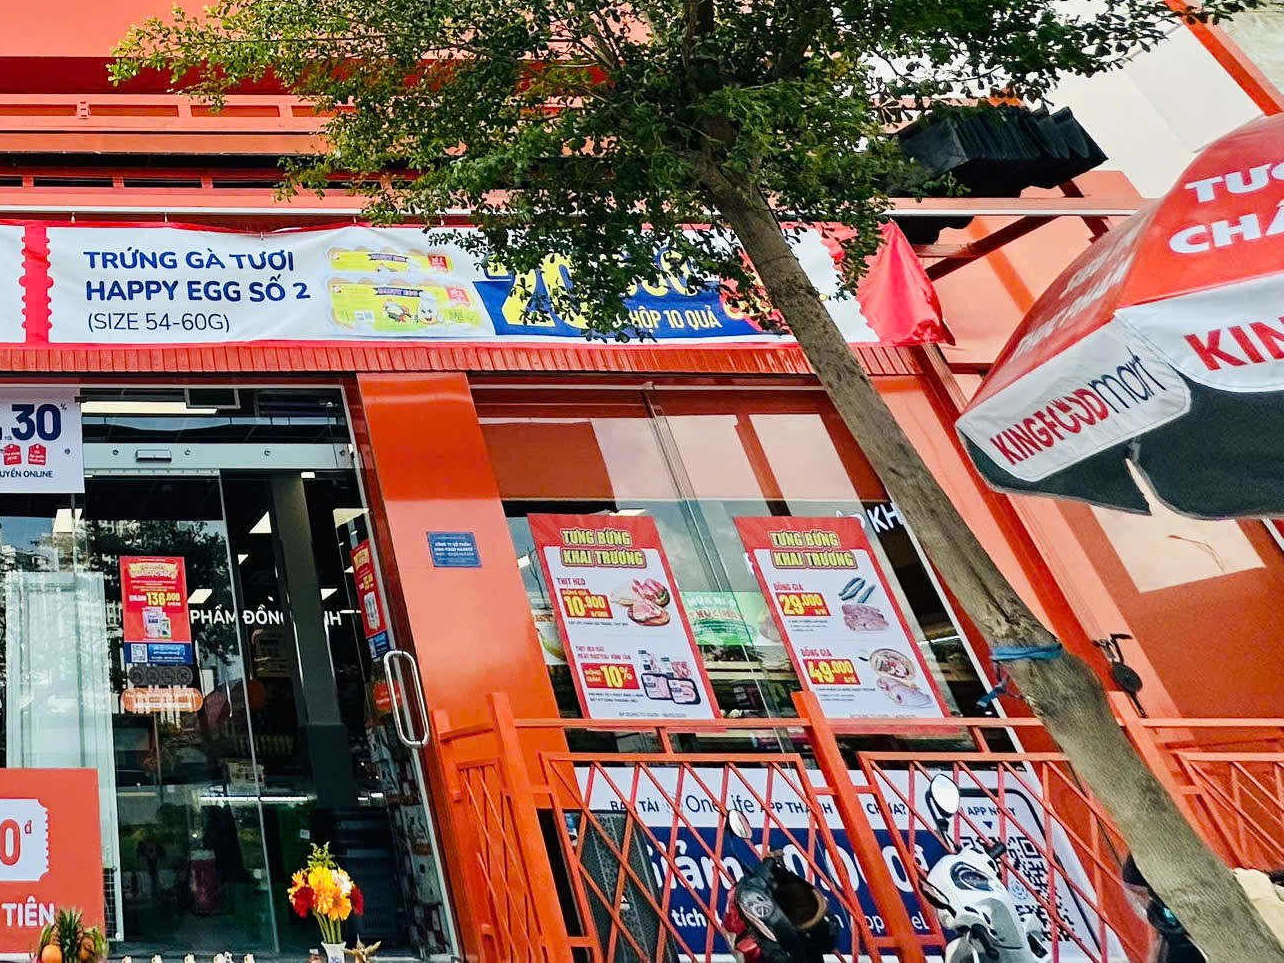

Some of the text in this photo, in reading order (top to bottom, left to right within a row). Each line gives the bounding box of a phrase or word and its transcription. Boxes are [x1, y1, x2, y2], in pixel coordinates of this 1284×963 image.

[83, 247, 294, 271] TRỨNG GÀ TƯƠI
[86, 274, 311, 303] HAPPY EGG SỐ 2
[87, 312, 230, 333] (SIZE 54-60G)
[663, 309, 685, 328] 10
[688, 304, 722, 329] QUẢ
[23, 470, 53, 478] ONLINE
[866, 502, 905, 533] KH
[563, 550, 592, 564] KHAI
[773, 551, 803, 566] KHAI
[572, 577, 585, 586] HEO
[146, 592, 180, 606] 136.000
[564, 595, 605, 616] 10.900
[778, 593, 823, 615] 29.000
[189, 603, 237, 625] PHẨM
[600, 665, 633, 688] 10%
[808, 660, 853, 683] 49.000
[638, 797, 660, 812] TẢI
[685, 794, 755, 813] Oneife
[968, 806, 986, 816] APP
[1, 895, 56, 927] TIÊN
[671, 906, 707, 927] tích
